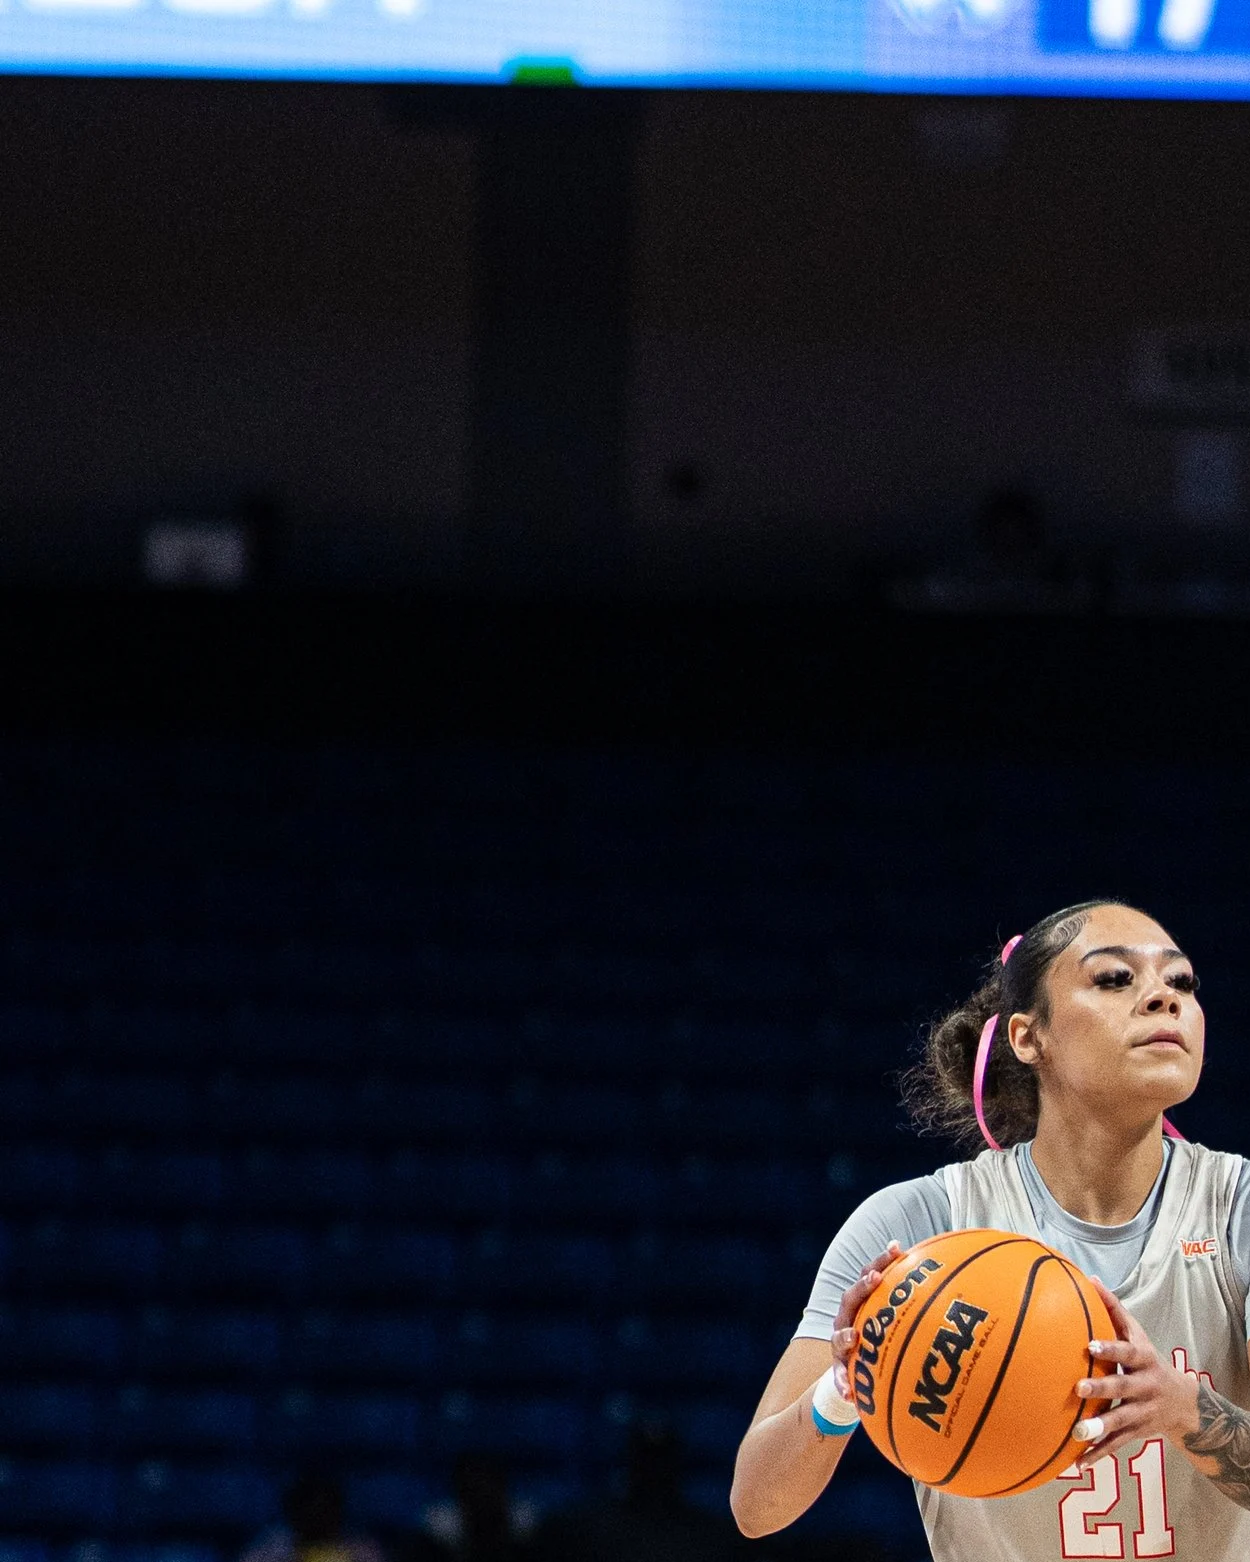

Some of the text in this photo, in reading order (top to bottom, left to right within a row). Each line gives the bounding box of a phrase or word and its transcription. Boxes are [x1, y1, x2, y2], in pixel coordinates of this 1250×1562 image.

[908, 1299, 989, 1433] NCAA
[977, 1318, 998, 1348] BALL
[1057, 1438, 1175, 1560] 21
